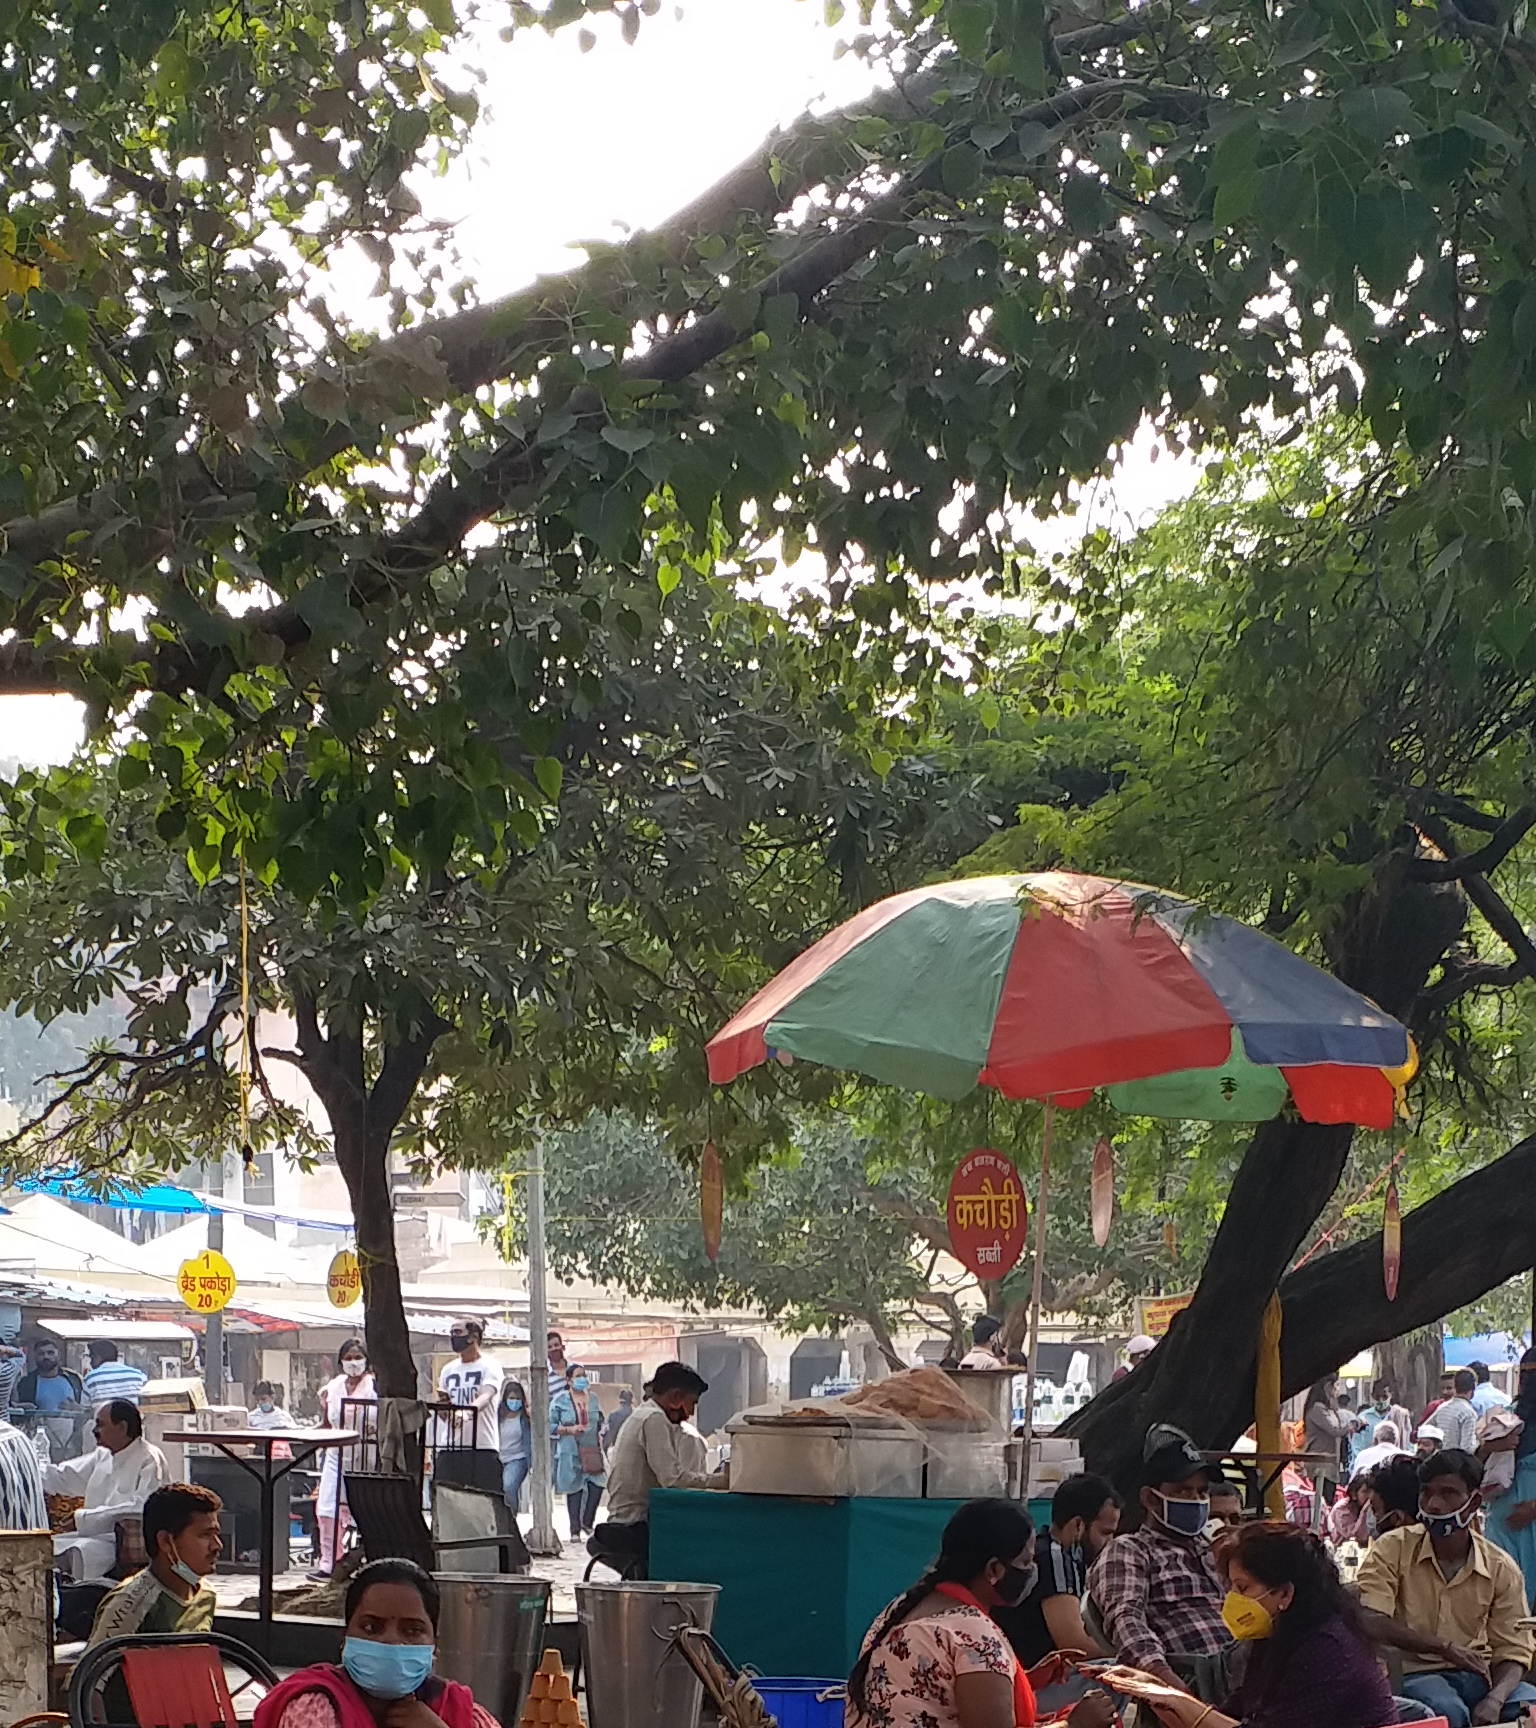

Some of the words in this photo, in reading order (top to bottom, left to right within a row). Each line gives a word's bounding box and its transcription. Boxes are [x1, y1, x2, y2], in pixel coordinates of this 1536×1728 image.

[954, 1177, 1020, 1241] कचौड़ी
[202, 1253, 211, 1270] 1
[199, 1271, 231, 1296] पकोड़ा
[197, 1294, 213, 1308] 20
[336, 1290, 346, 1304] 20
